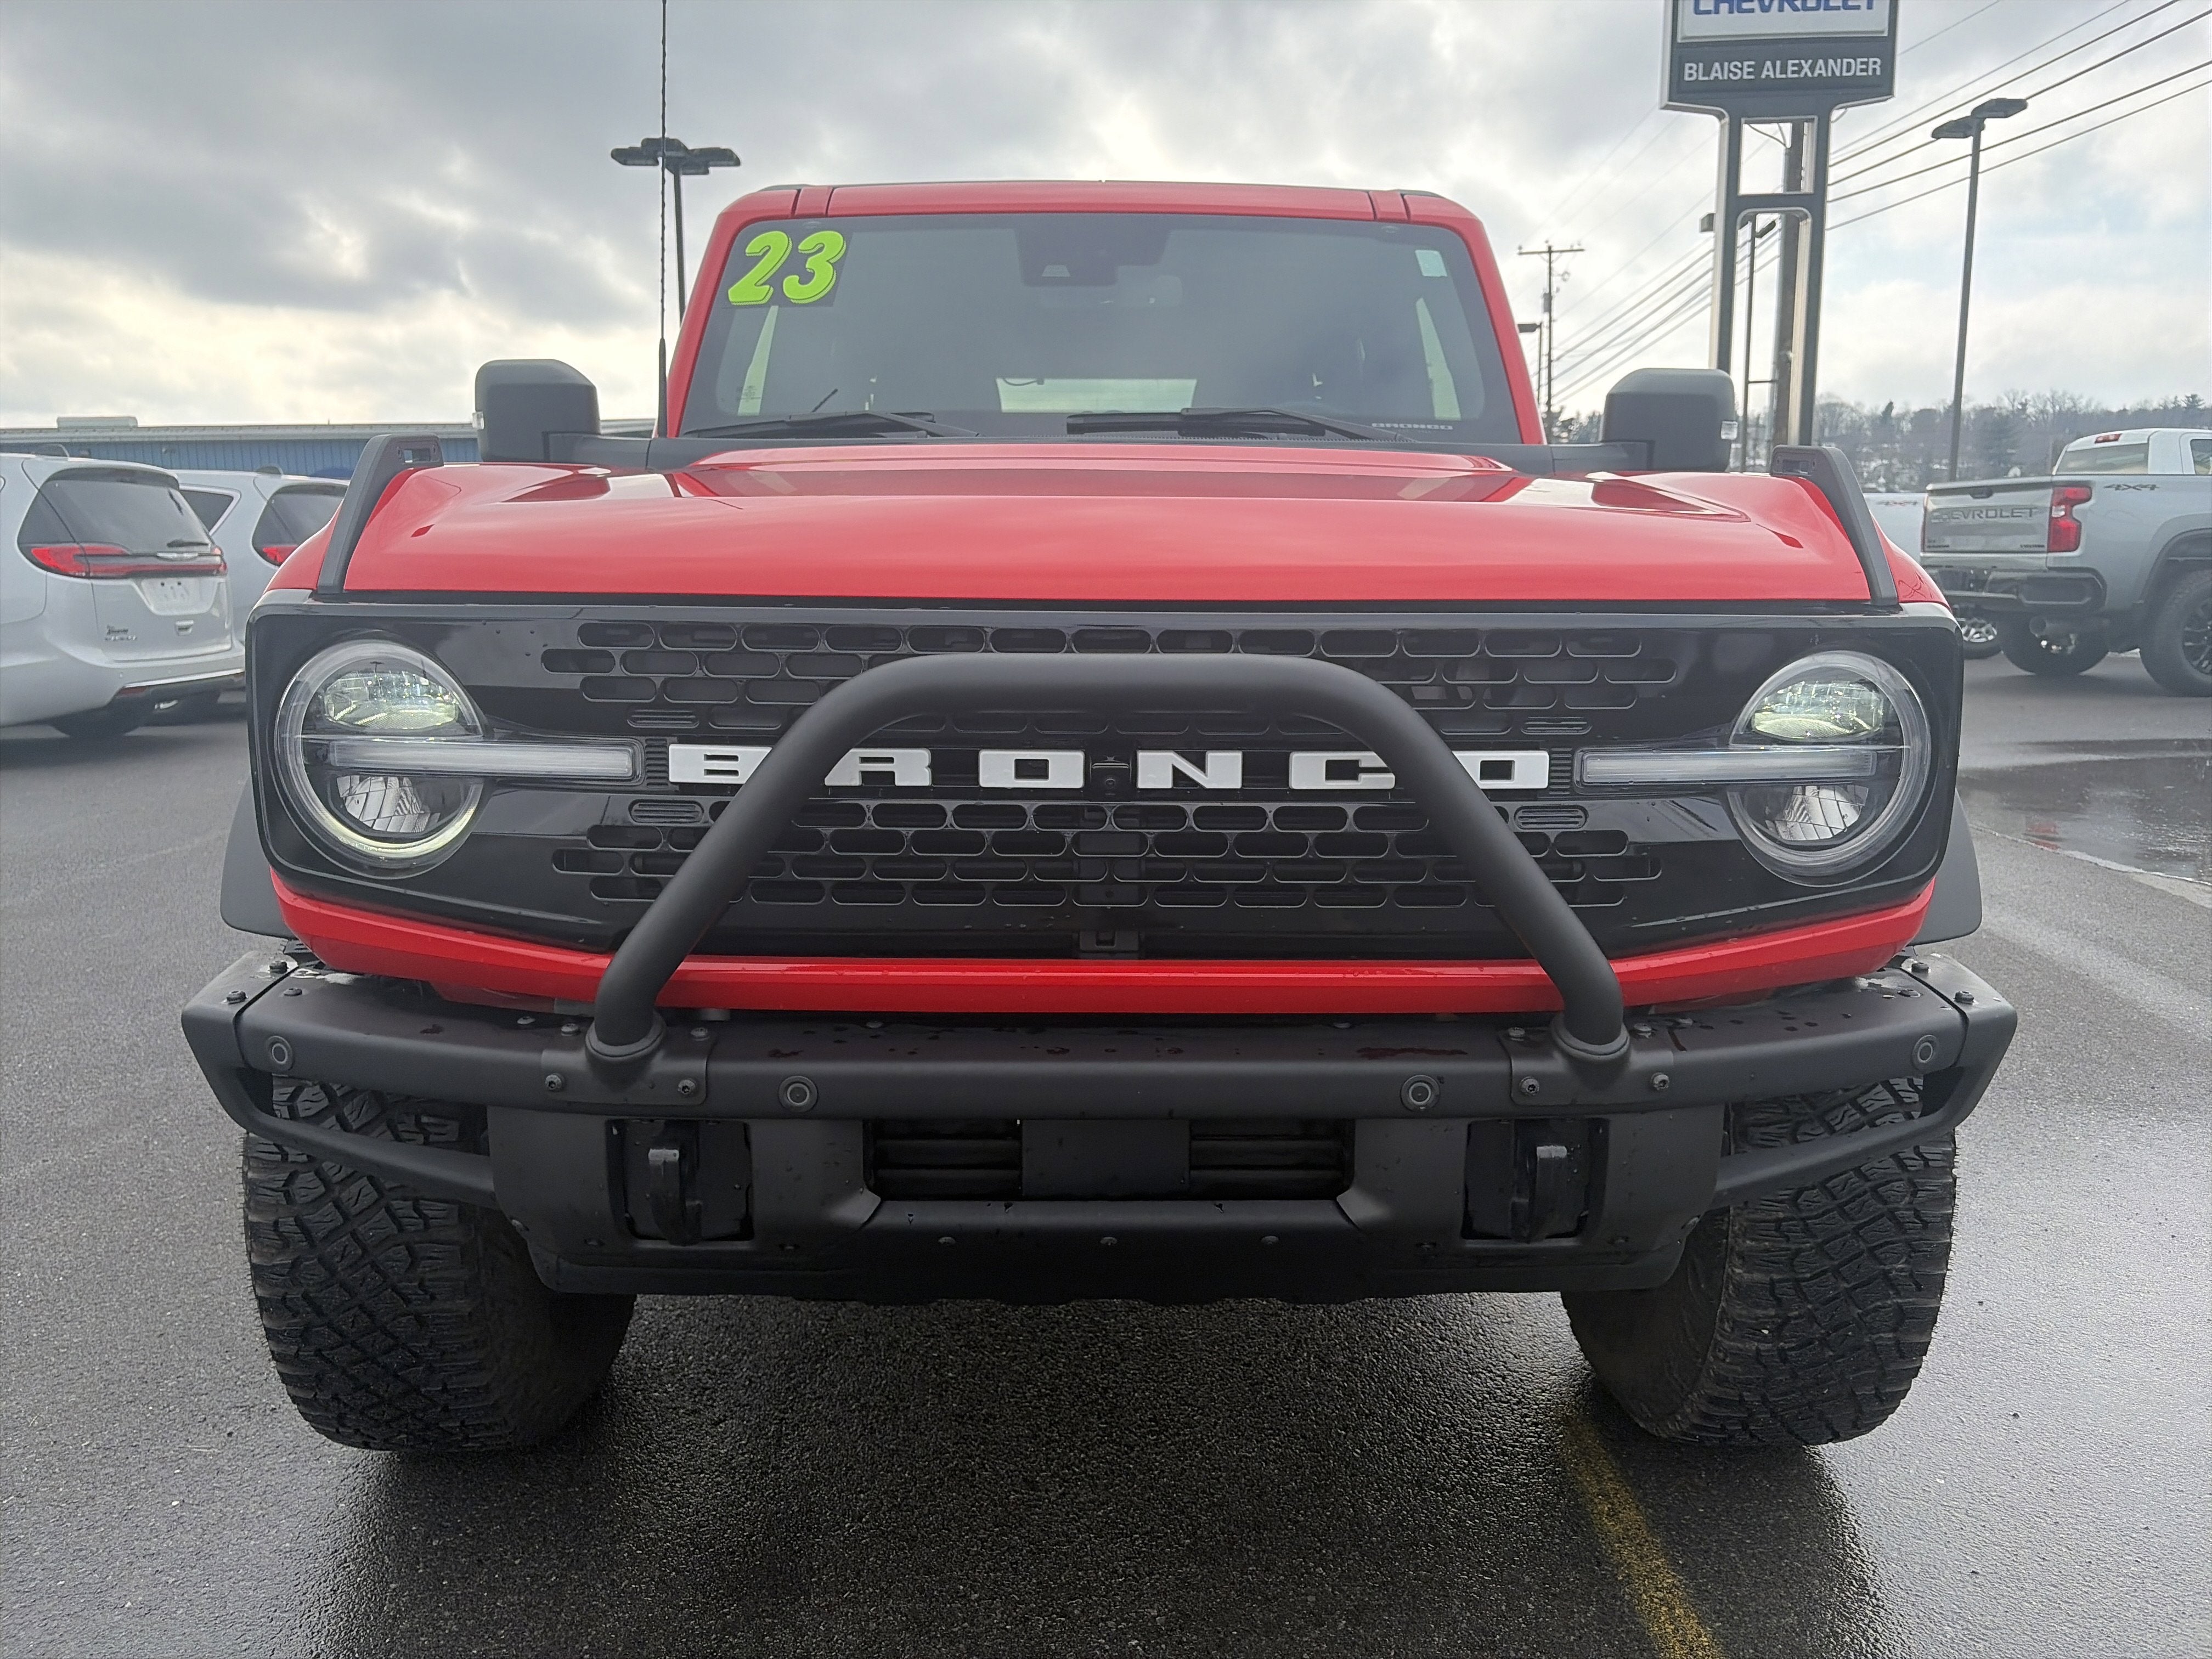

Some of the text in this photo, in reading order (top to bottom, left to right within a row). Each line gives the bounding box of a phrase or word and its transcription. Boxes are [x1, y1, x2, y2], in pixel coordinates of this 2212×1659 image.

[1684, 58, 1882, 81] BLAISE ALEXANDER
[728, 230, 847, 306] 23
[668, 743, 1550, 790] BRONCO
